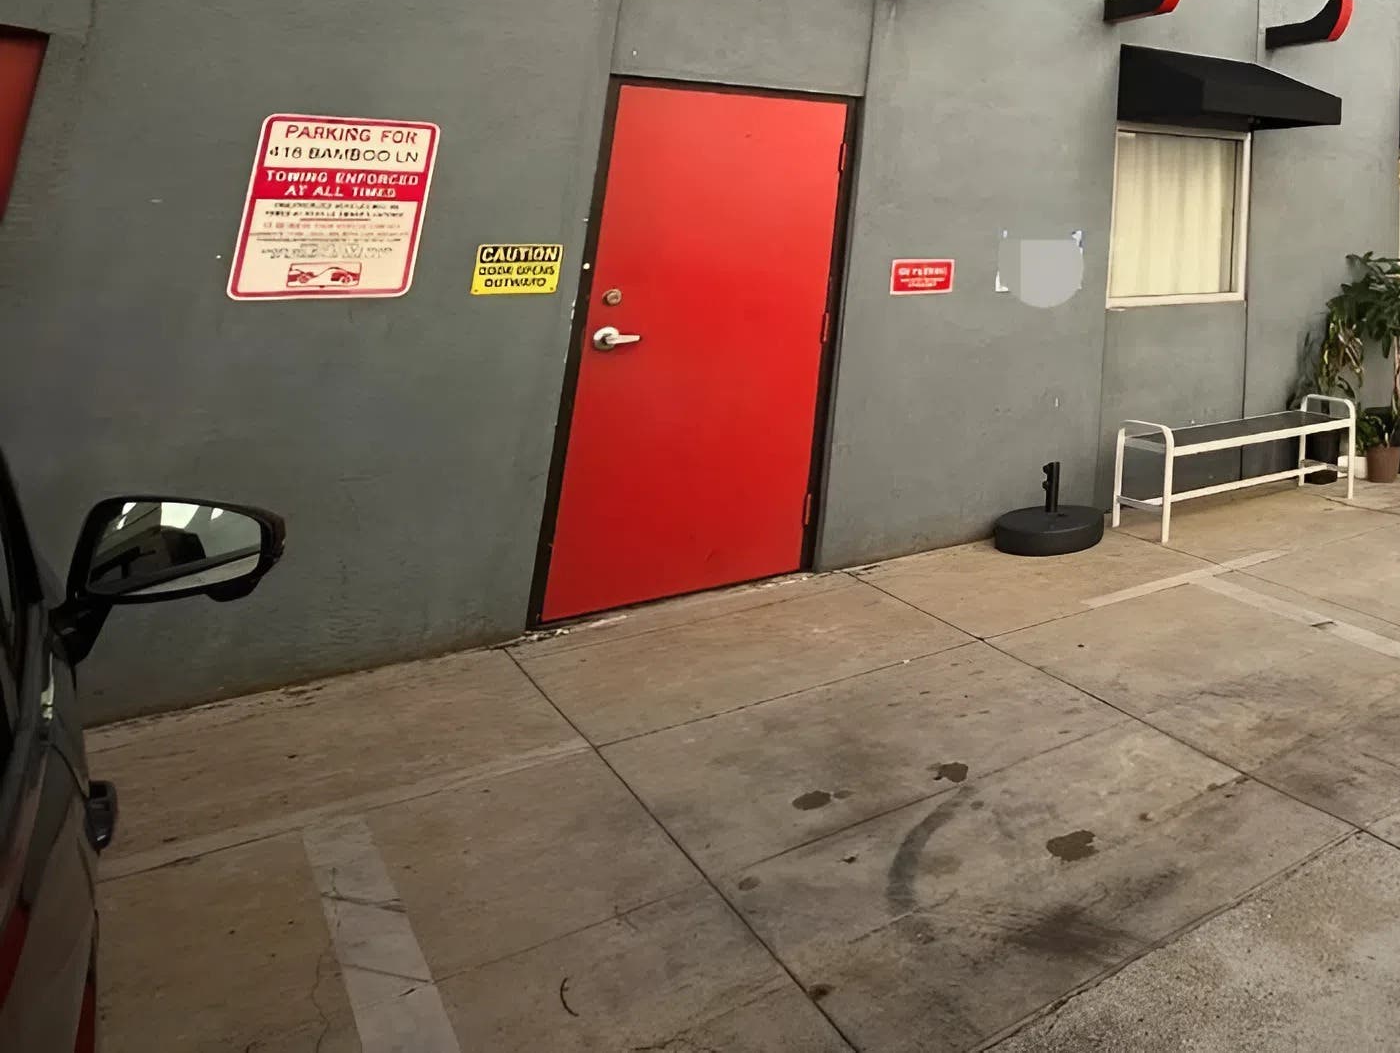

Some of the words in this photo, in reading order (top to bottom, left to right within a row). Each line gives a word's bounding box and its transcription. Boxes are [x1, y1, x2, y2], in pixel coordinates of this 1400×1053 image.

[285, 124, 371, 143] PARKING
[380, 129, 418, 145] FOR
[308, 147, 391, 162] BAMBOO
[396, 149, 419, 163] LN
[265, 169, 328, 183] TOWING
[335, 171, 419, 186] ENFORCED
[312, 185, 344, 197] ALL
[481, 246, 558, 262] CAUTION
